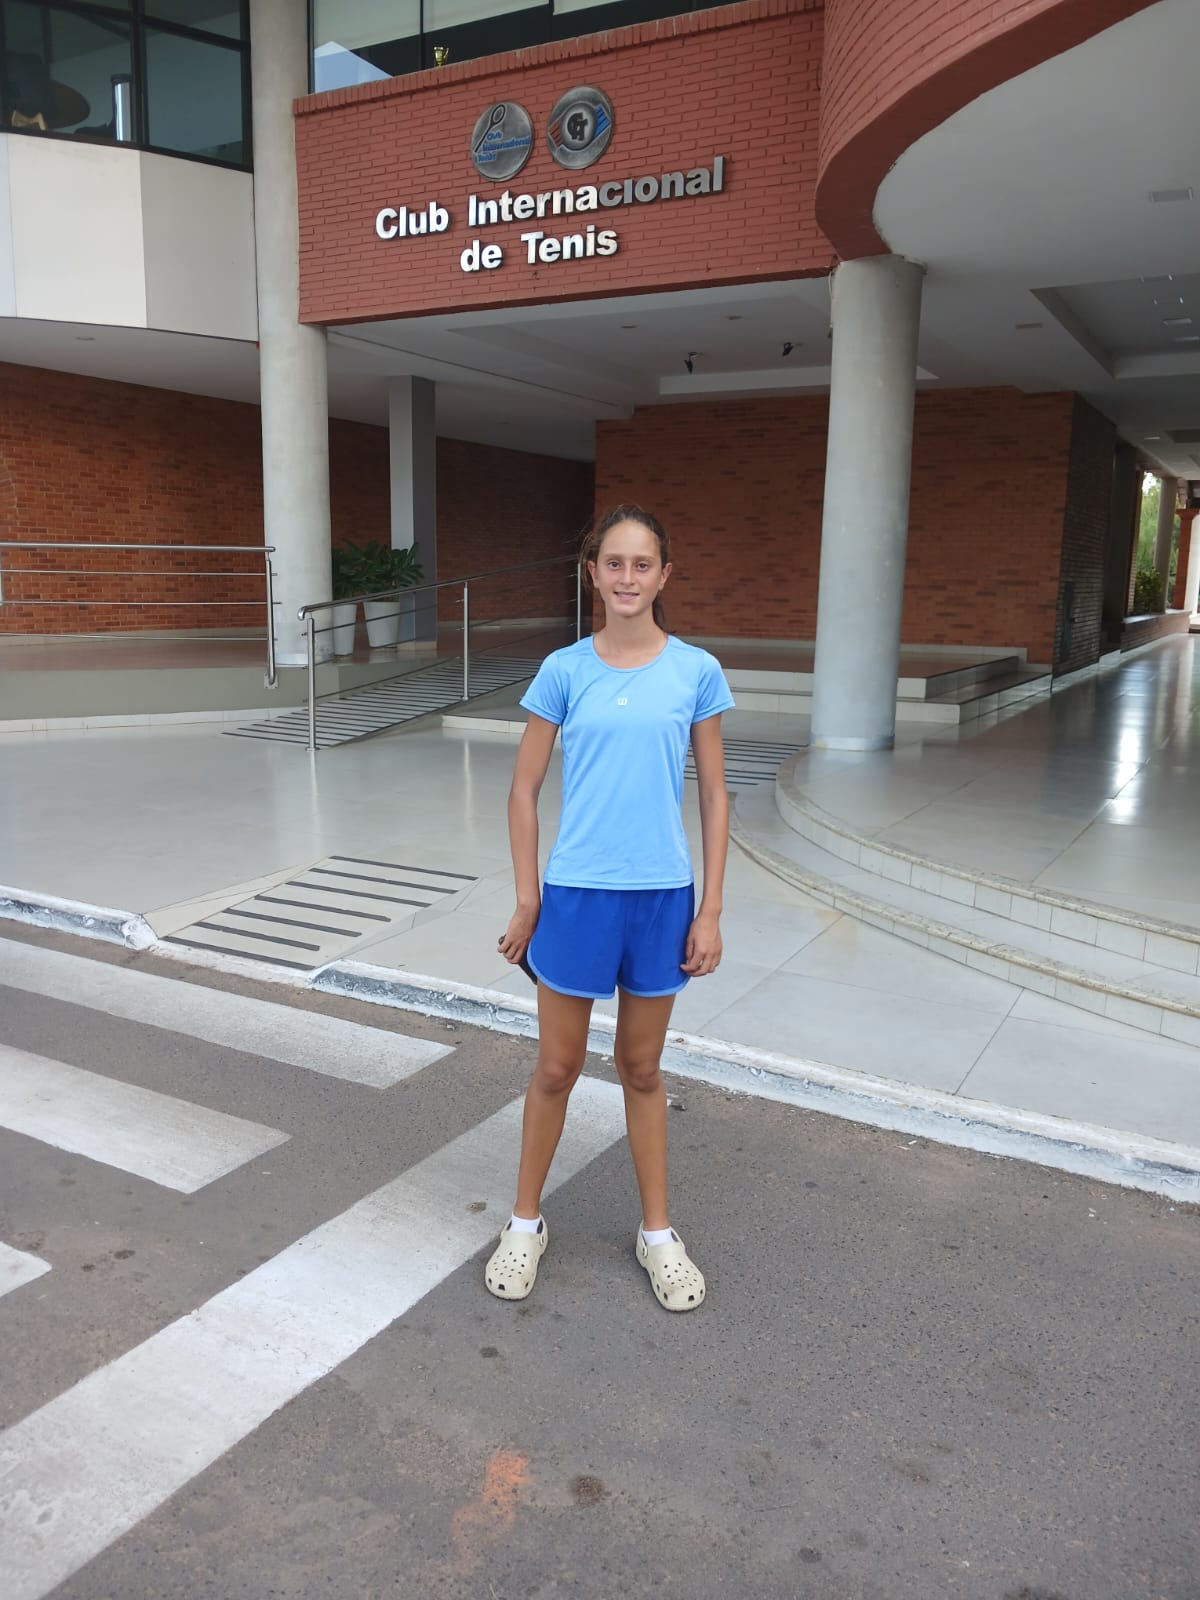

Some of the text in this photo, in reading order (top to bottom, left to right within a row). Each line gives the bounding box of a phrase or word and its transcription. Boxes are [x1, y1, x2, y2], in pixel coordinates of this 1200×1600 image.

[375, 156, 725, 240] Club Internacional
[460, 224, 619, 272] de Tenis
